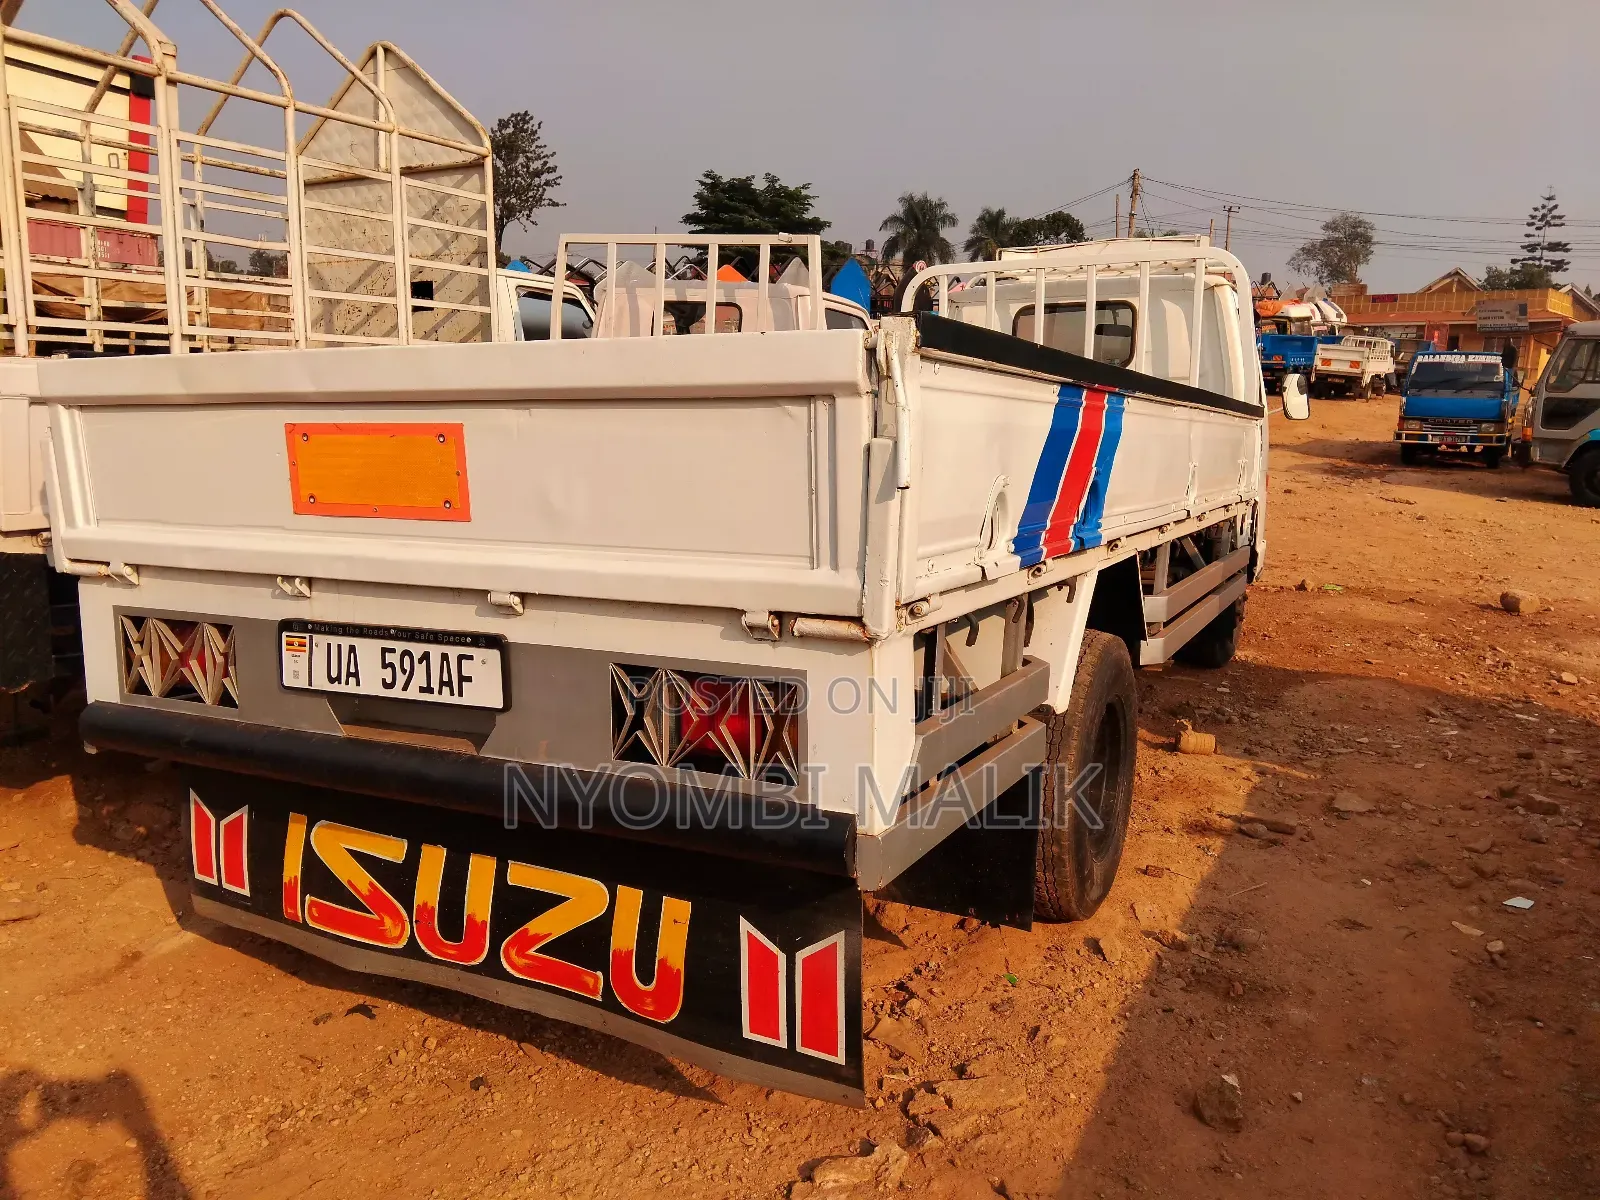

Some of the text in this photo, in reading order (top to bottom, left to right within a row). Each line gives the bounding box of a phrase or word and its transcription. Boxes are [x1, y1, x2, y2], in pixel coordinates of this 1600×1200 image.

[314, 623, 466, 643] Making the Roads Your Safe Space
[326, 642, 475, 698] UA 591AF
[282, 811, 691, 1023] ISUZU
